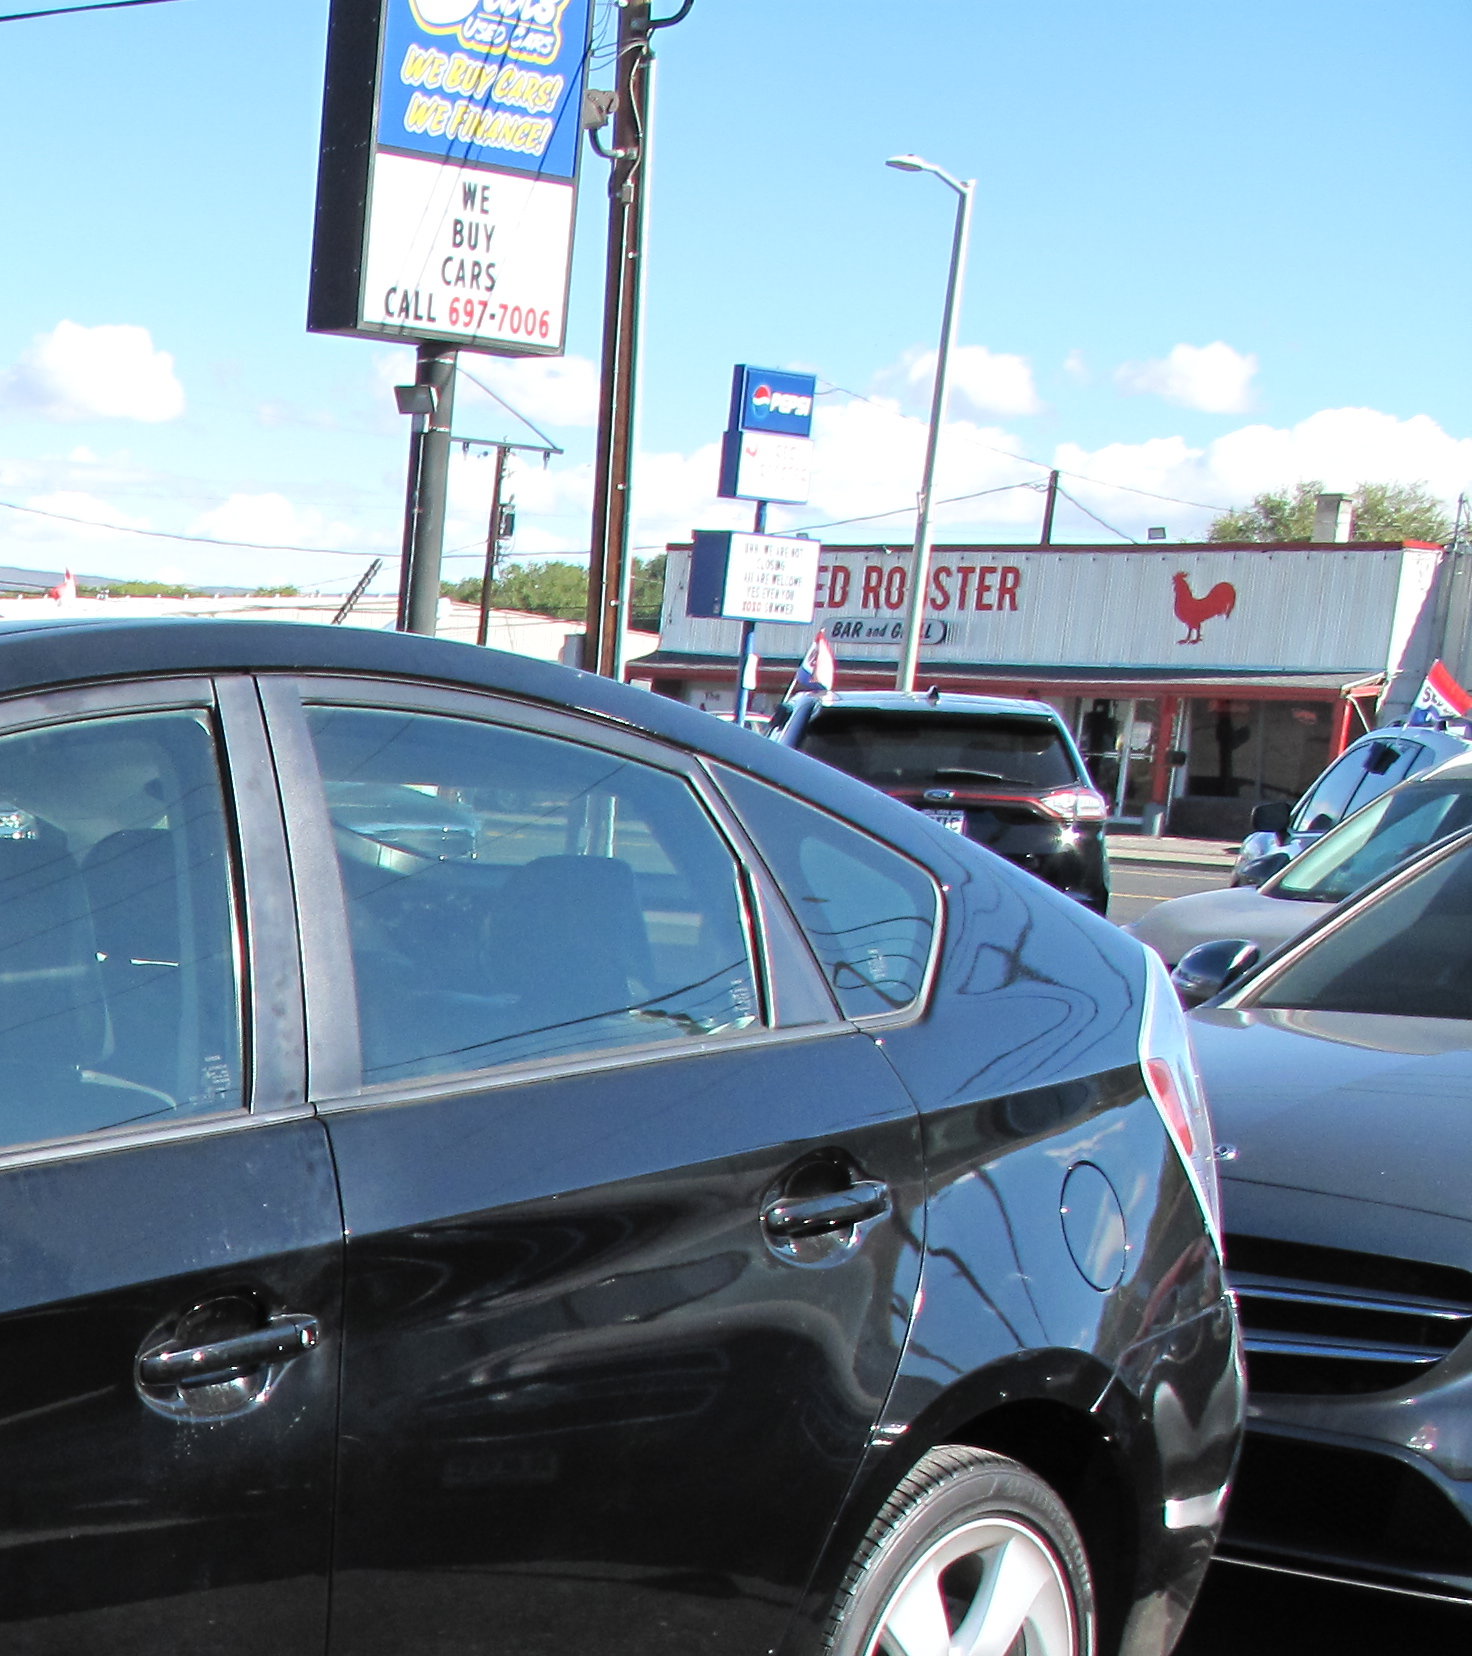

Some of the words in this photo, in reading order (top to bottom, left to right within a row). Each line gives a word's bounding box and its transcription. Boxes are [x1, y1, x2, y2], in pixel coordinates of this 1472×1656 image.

[403, 50, 447, 84] WE
[445, 57, 497, 96] BUY
[494, 68, 561, 111] CARS!
[407, 98, 450, 132] WE
[450, 104, 550, 152] FINANCE!
[461, 181, 491, 215] WE
[452, 218, 496, 254] BUY
[441, 256, 497, 293] CARS
[384, 286, 437, 323] CALL
[448, 296, 550, 340] 697-7006
[814, 565, 851, 609] ED
[861, 565, 1021, 612] ROSTER
[831, 621, 862, 639] BAR
[865, 623, 888, 638] and
[890, 622, 932, 640] GLL
